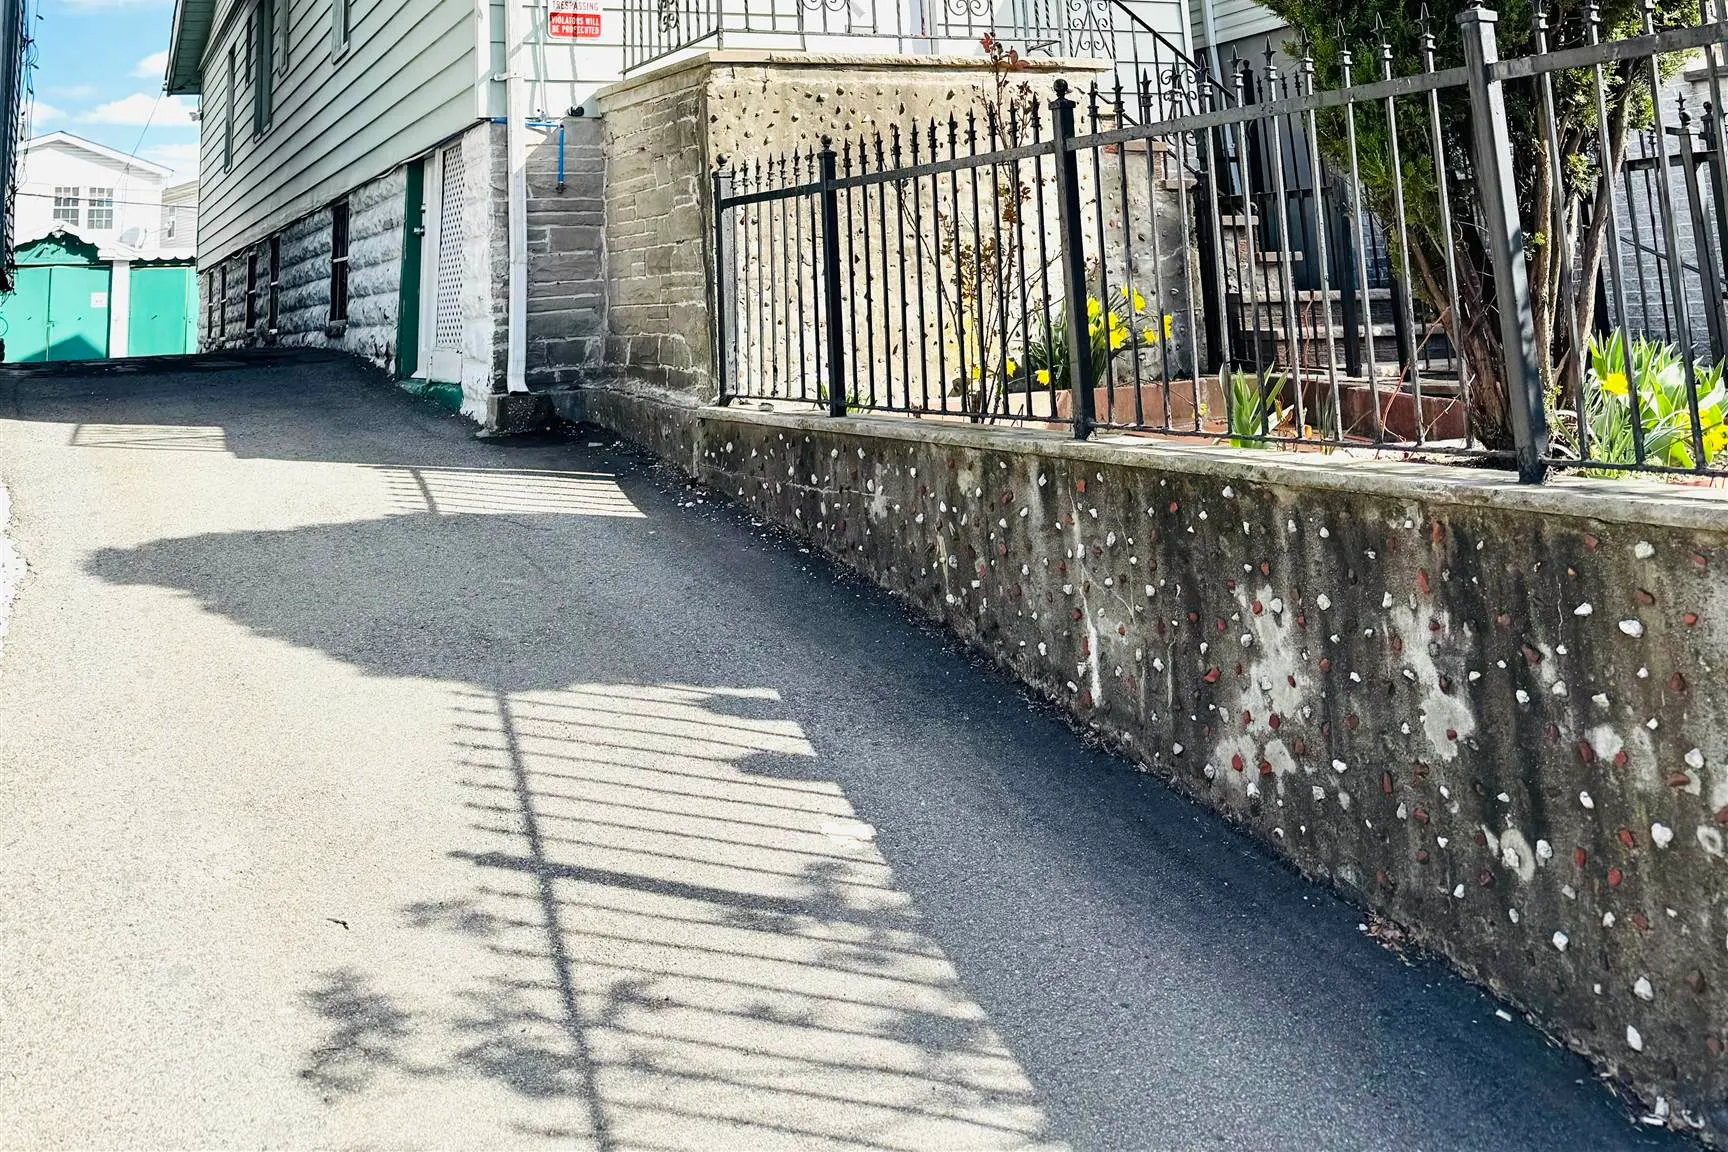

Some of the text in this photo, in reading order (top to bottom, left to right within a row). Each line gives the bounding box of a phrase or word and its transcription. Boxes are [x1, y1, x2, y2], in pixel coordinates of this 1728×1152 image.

[552, 0, 599, 11] TRESPASSING
[551, 16, 600, 26] VIOLATORS WILL
[552, 25, 600, 34] BE PROSECUTED
